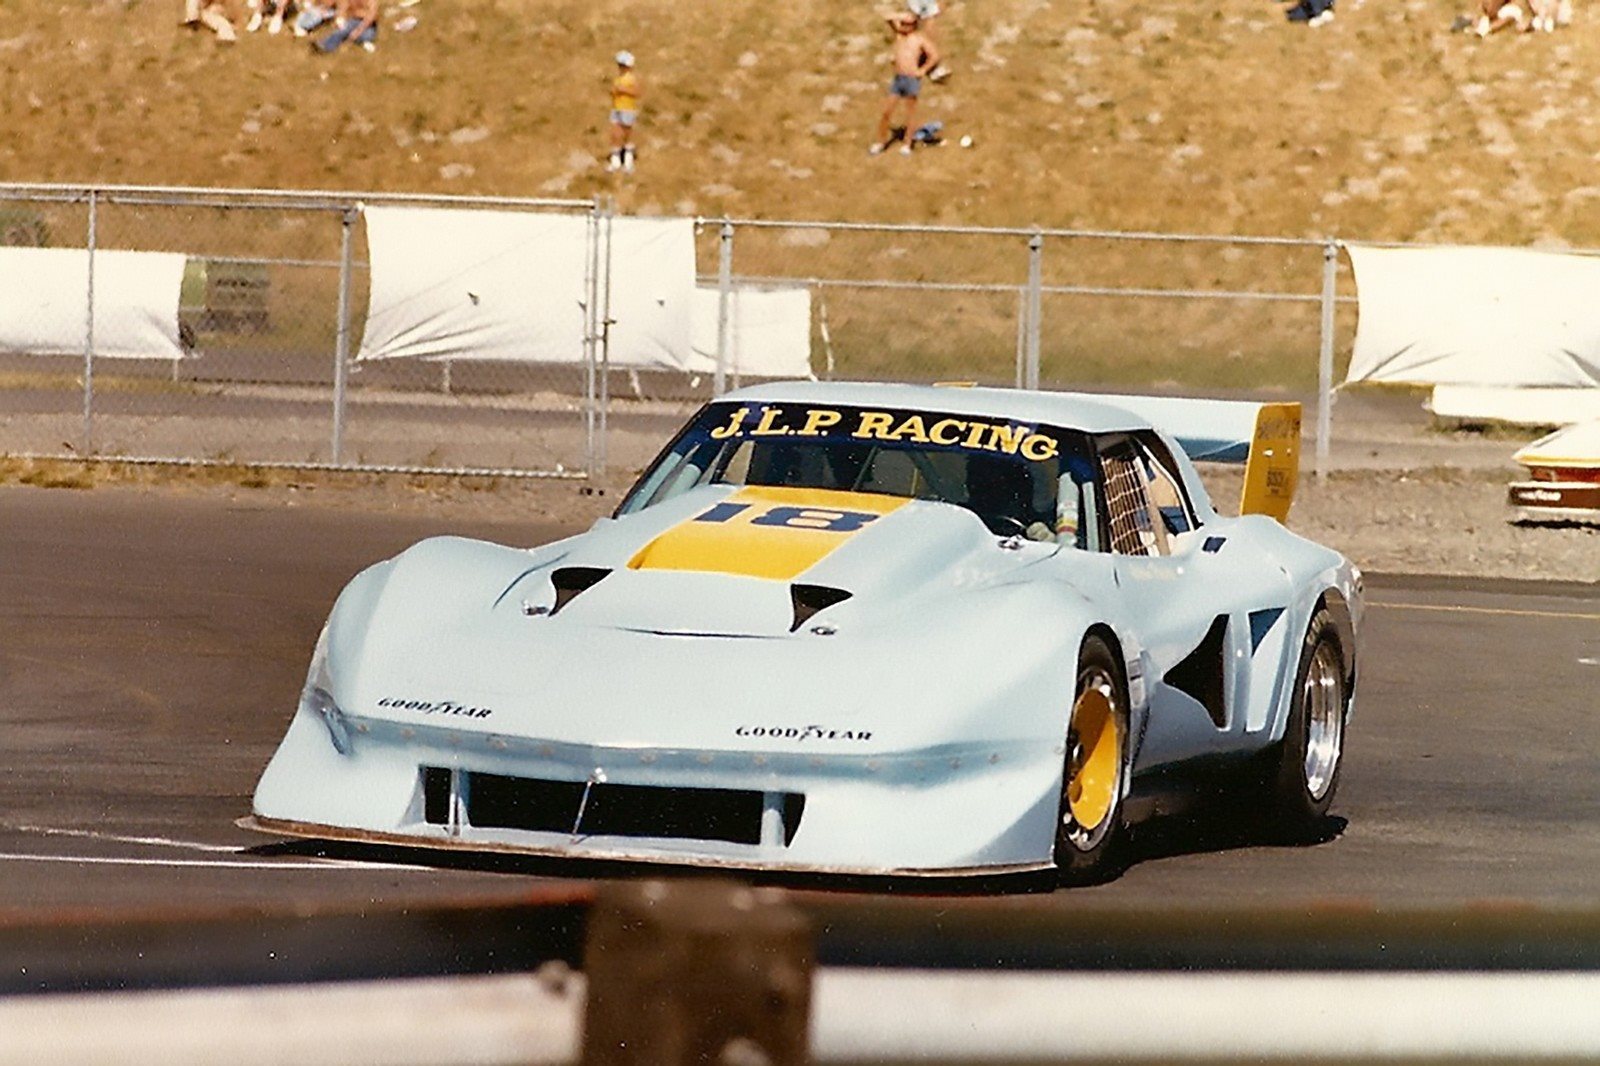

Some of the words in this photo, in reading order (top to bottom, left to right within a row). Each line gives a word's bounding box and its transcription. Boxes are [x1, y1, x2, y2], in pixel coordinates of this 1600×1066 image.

[851, 411, 1059, 461] RACING
[692, 502, 881, 532] 18
[735, 725, 872, 741] GOODYEAR
